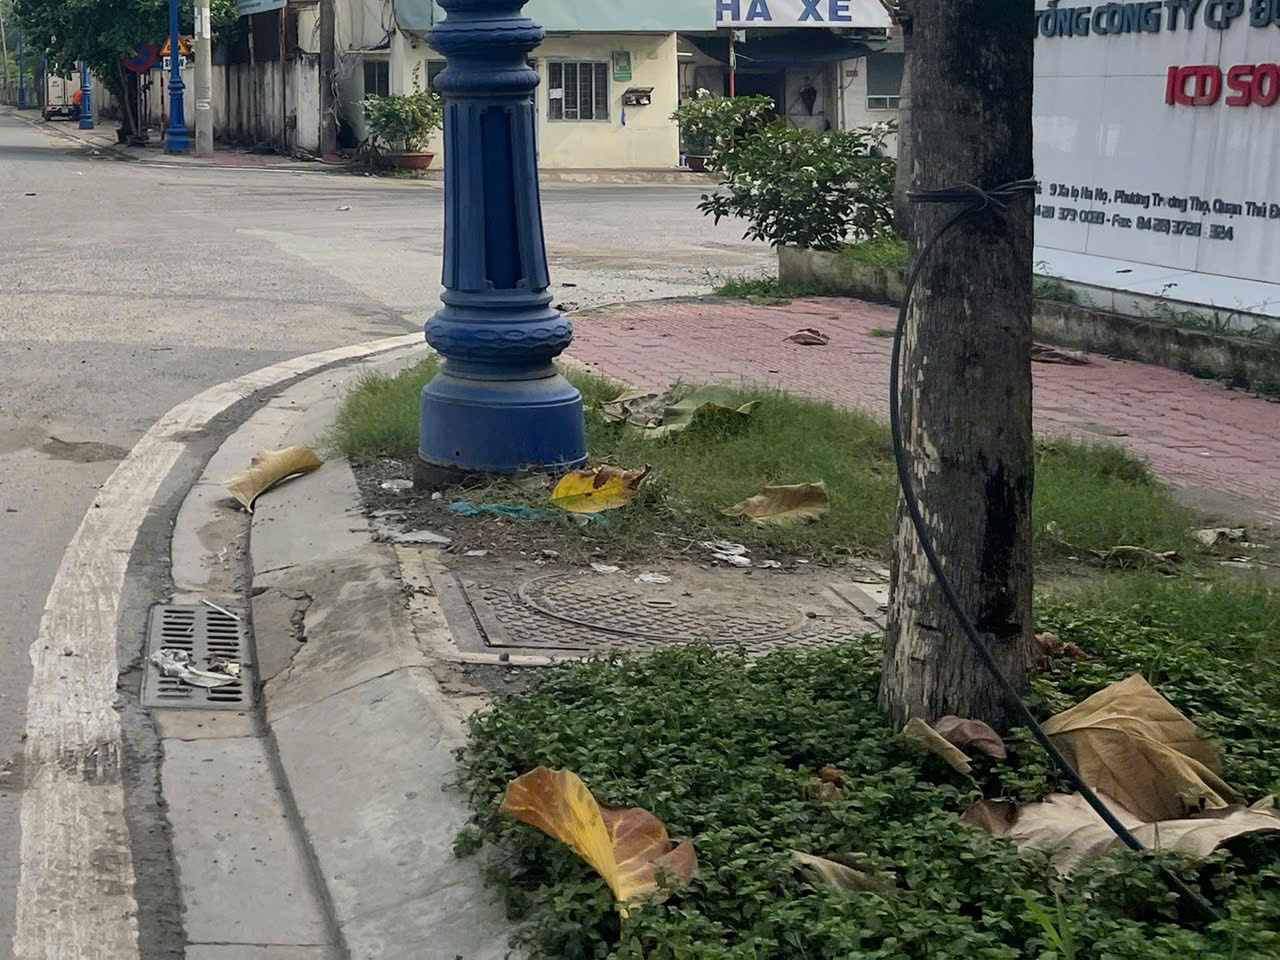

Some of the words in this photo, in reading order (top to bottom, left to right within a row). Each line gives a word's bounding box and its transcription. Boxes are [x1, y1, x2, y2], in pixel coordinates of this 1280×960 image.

[1091, 0, 1163, 36] CÔNG
[1165, 64, 1222, 106] ICD
[1225, 63, 1280, 107] SO
[1049, 183, 1057, 197] 9
